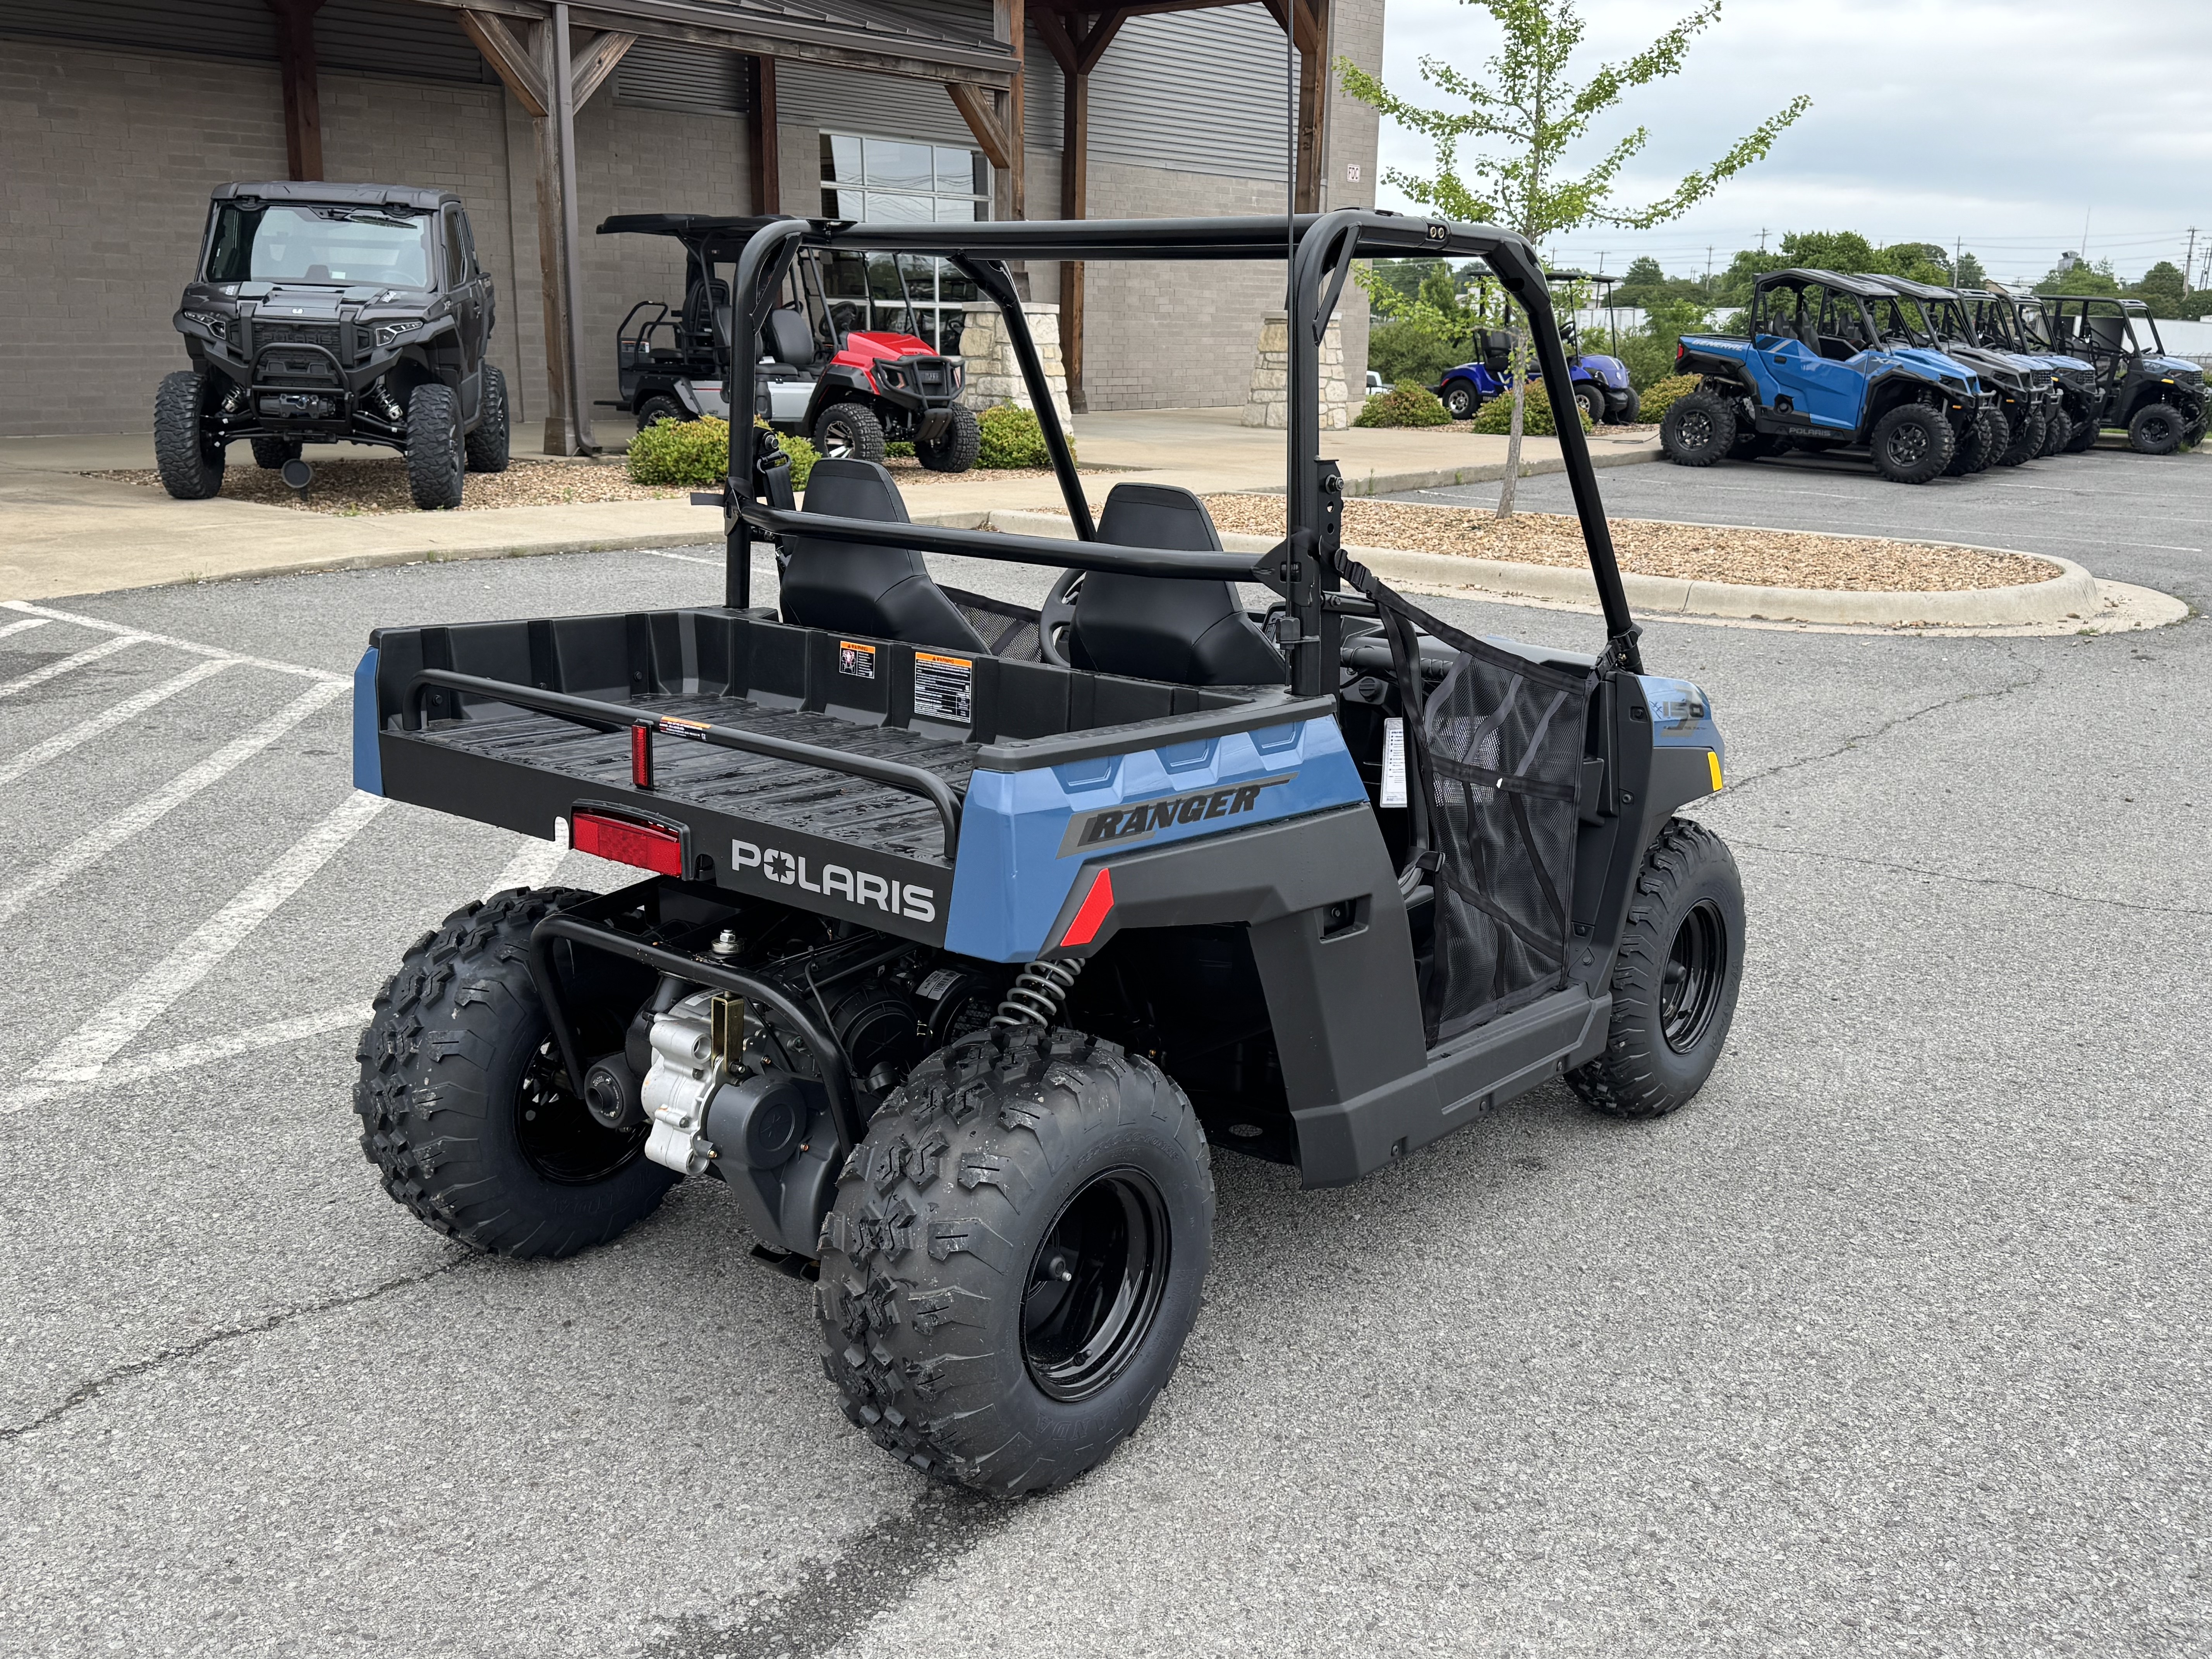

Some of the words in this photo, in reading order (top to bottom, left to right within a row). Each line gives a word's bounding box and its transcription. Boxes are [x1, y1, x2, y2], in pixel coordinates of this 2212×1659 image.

[1348, 167, 1358, 179] FDC
[263, 332, 332, 344] POLARIS
[1692, 339, 1743, 351] GENERAL
[1789, 427, 1831, 436] POLARIS
[1087, 785, 1261, 842] RANGER
[732, 839, 935, 922] POLARIS
